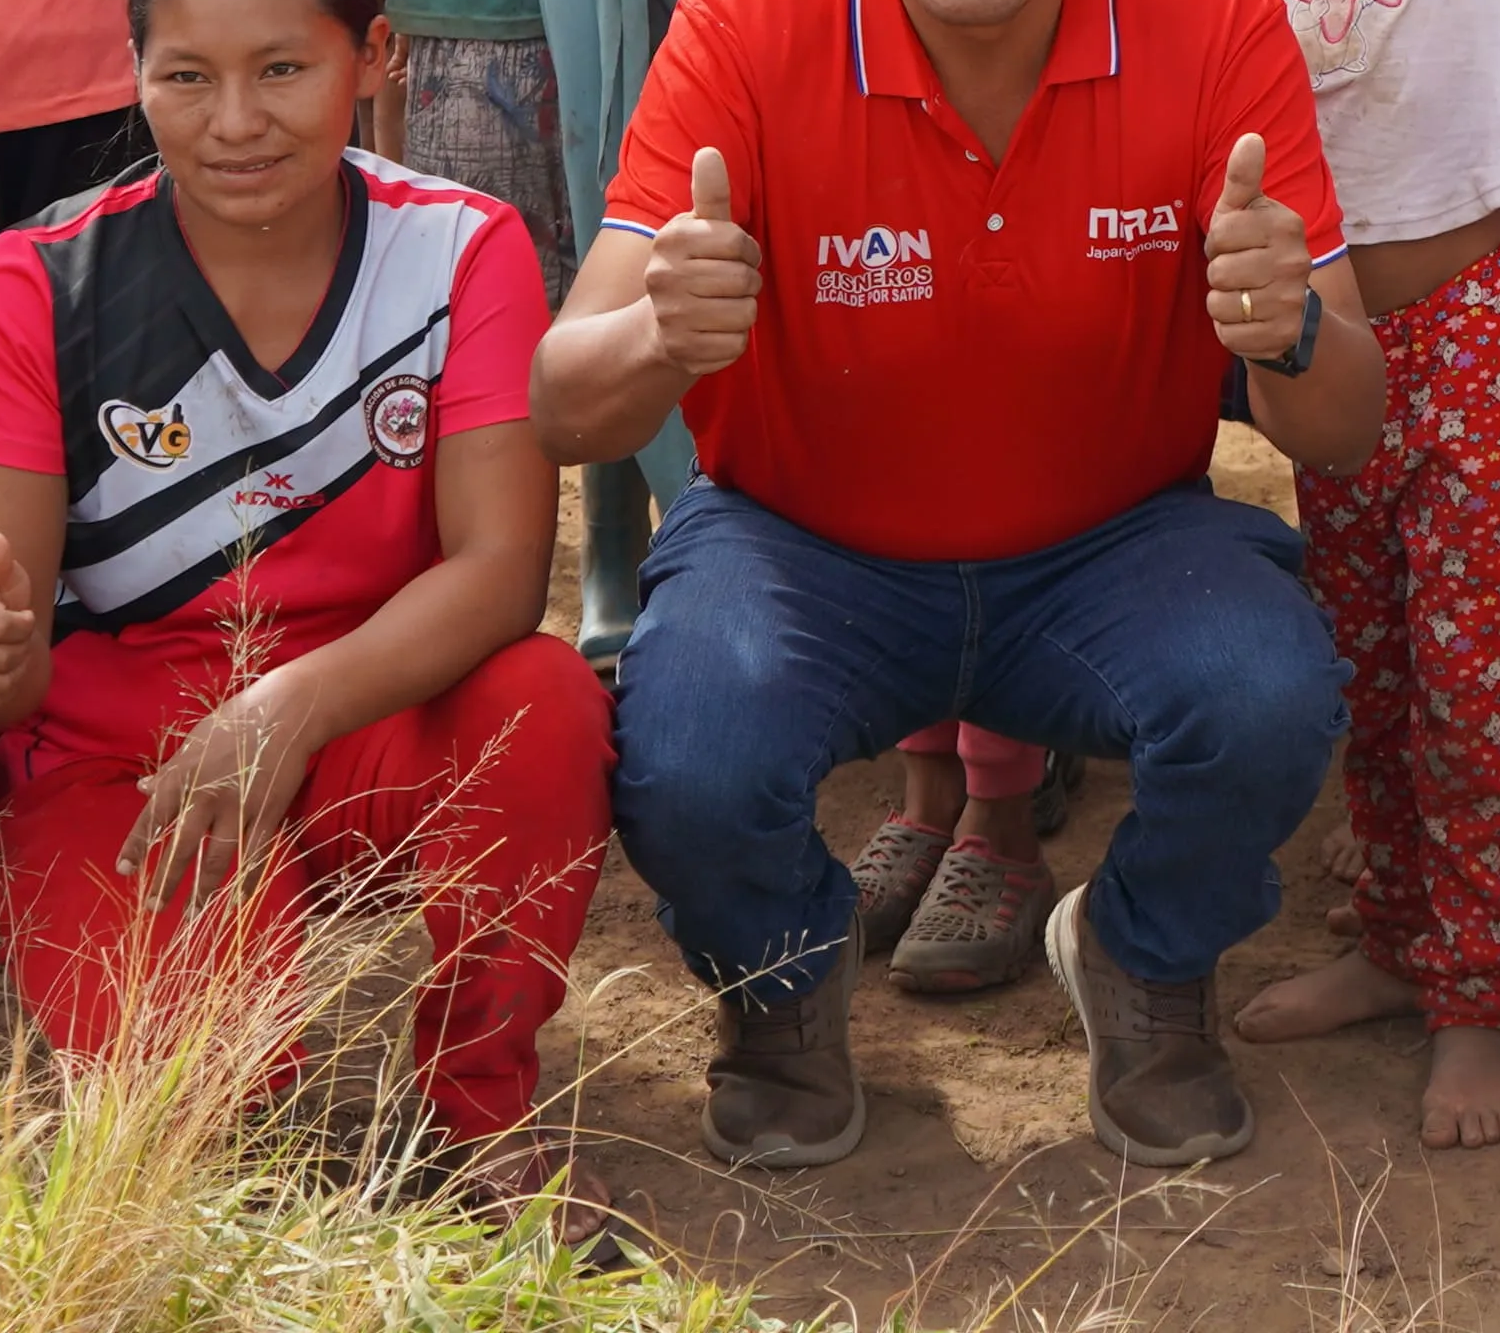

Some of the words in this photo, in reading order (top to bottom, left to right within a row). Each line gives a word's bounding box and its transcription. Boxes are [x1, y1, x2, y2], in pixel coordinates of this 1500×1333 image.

[817, 226, 933, 270] IVAN
[1086, 244, 1127, 262] Japan
[1125, 238, 1180, 262] chnology
[816, 264, 933, 294] CISNEROS
[815, 289, 866, 308] ALCALDE
[867, 289, 889, 306] POR
[891, 285, 934, 303] SATIPO
